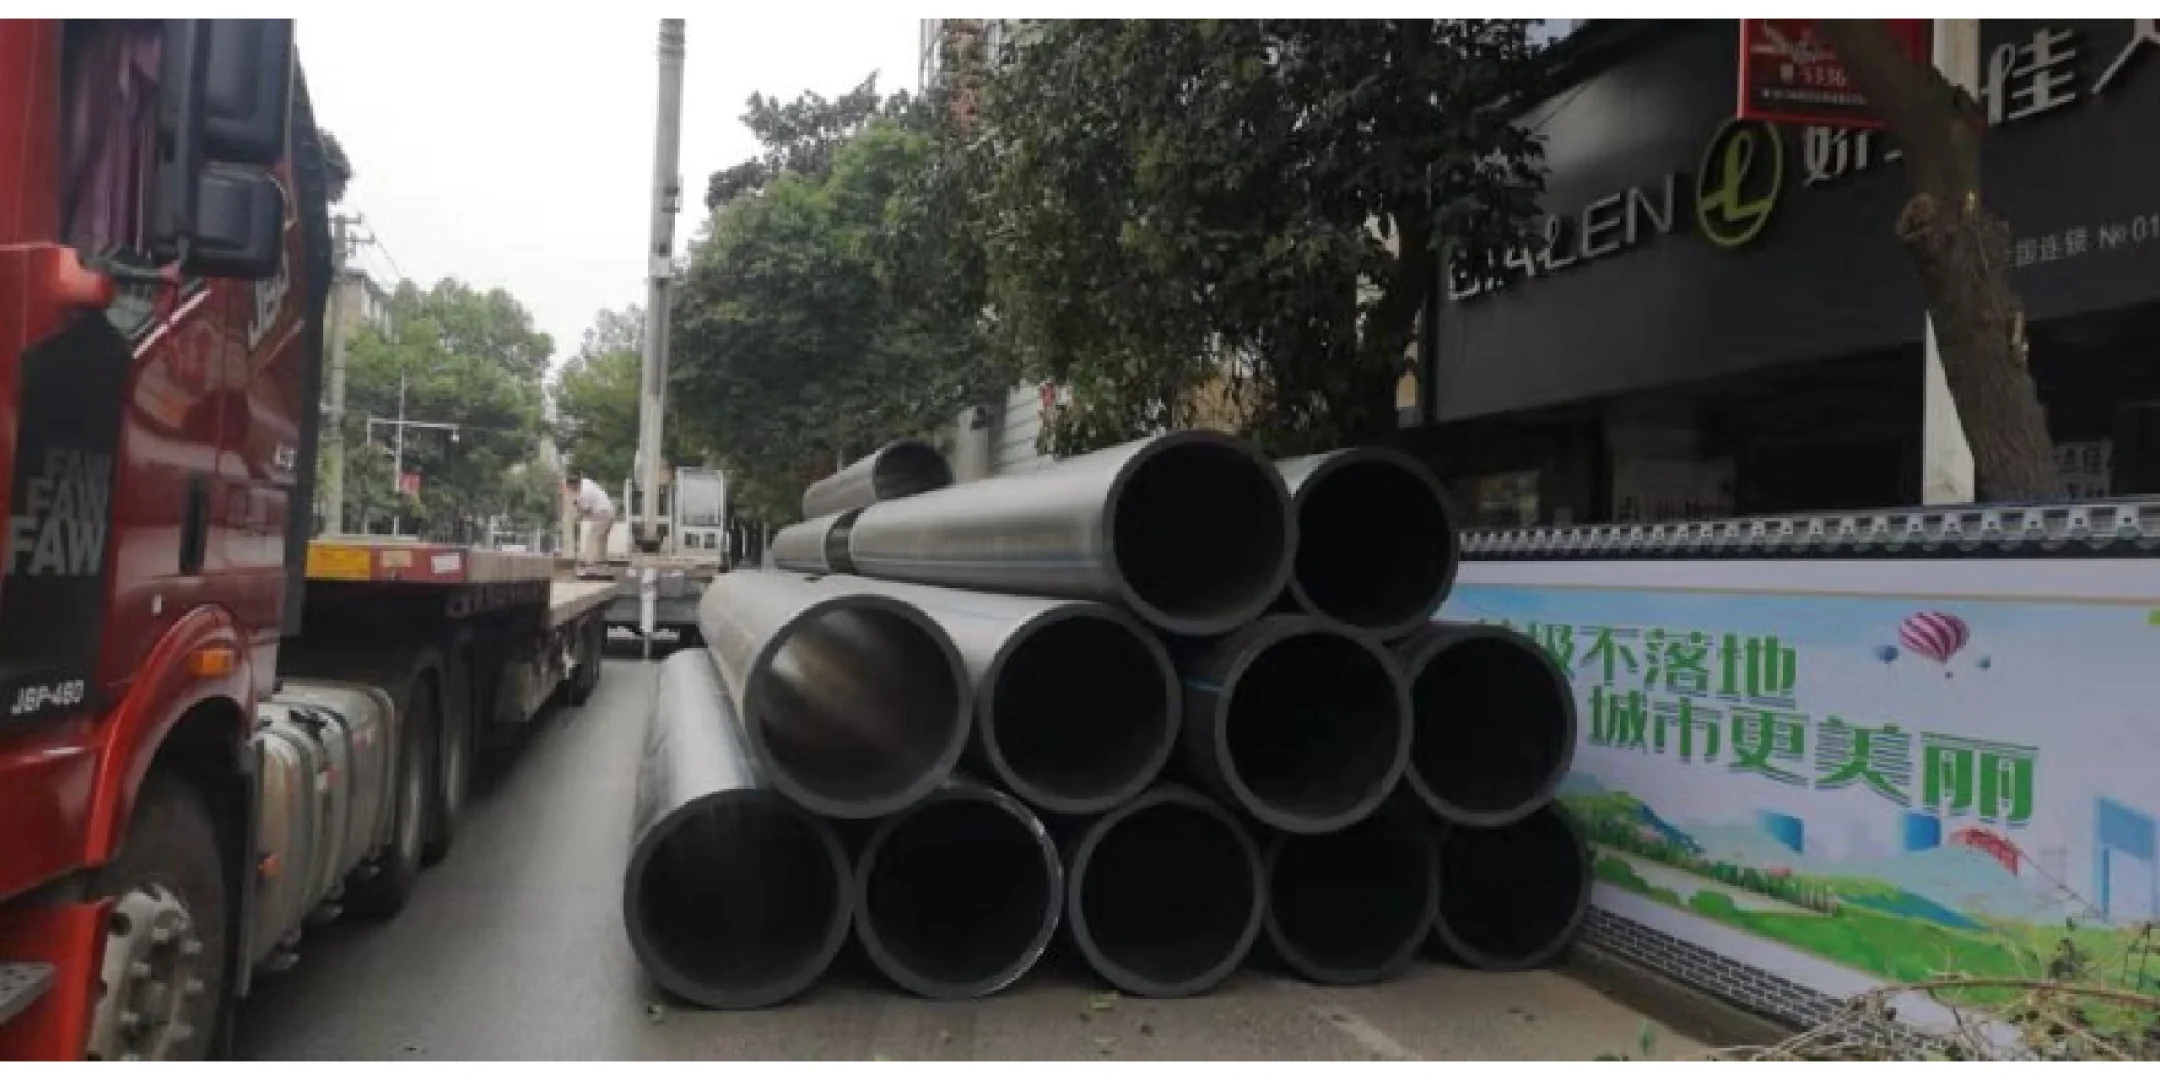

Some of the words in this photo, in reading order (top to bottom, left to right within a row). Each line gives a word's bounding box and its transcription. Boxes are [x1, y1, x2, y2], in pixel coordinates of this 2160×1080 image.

[2008, 231, 2088, 268] 国连锁
[6, 515, 107, 577] FAW
[1476, 621, 1799, 711] 圾不落地
[1588, 686, 2041, 826] 城市更美丽
